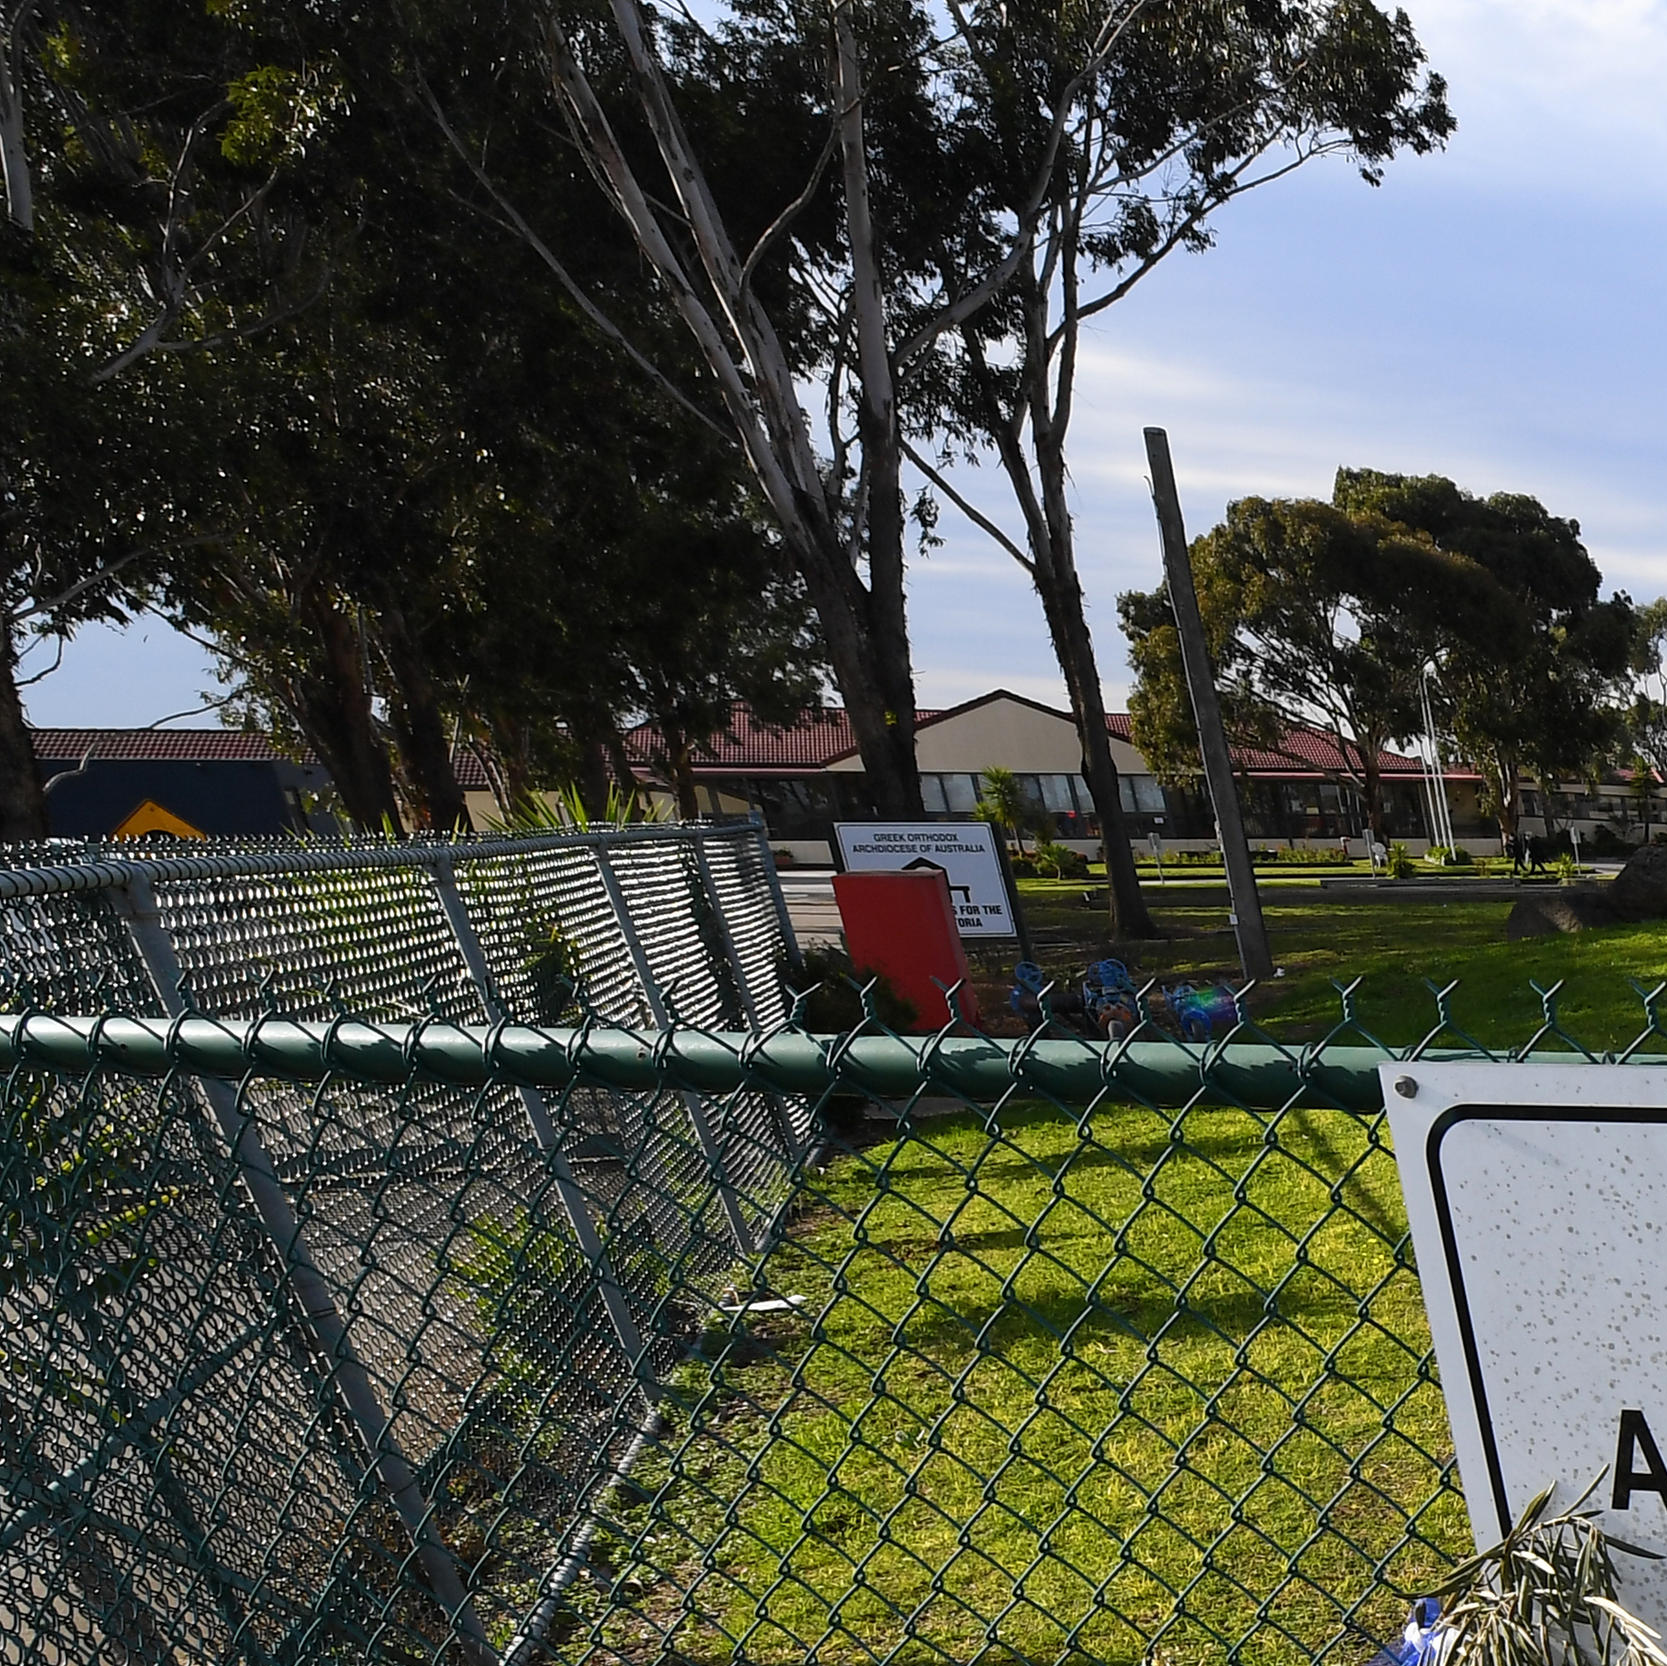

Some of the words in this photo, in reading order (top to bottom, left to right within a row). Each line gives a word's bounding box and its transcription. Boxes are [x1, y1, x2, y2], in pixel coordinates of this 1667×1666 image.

[873, 833, 905, 842] GREEK
[907, 833, 959, 842] ORTHODOX
[853, 844, 918, 853] ARCHDIOCESE
[919, 844, 931, 853] OF
[935, 844, 985, 853] AUSTRALIA
[959, 905, 981, 915] FOR
[982, 905, 1003, 915] THE
